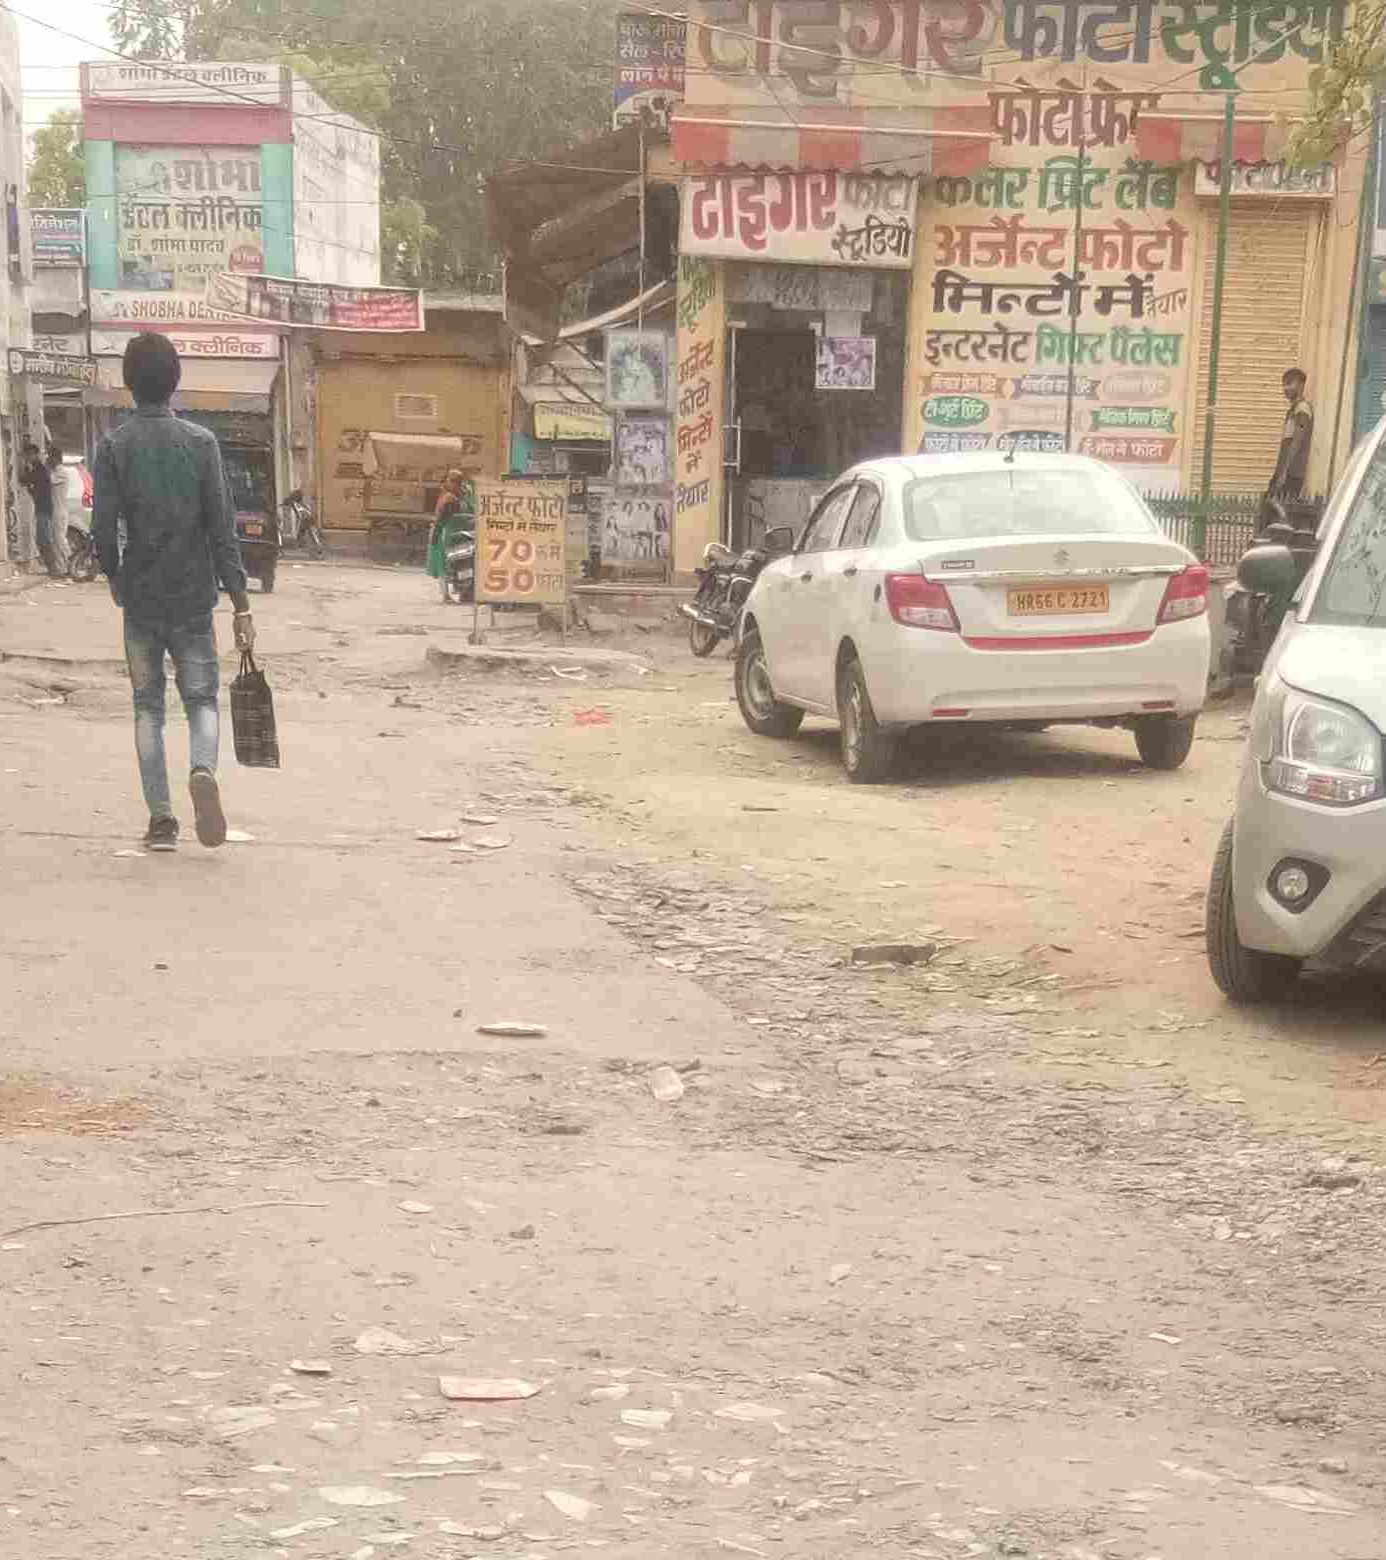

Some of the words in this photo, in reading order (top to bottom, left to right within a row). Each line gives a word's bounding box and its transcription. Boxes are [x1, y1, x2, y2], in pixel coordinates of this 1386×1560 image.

[933, 166, 1031, 208] कलर
[1077, 218, 1189, 271] फोटो
[132, 300, 185, 319] SHOBHA
[1093, 272, 1154, 318] में
[484, 539, 533, 562] 70
[483, 568, 534, 593] 50
